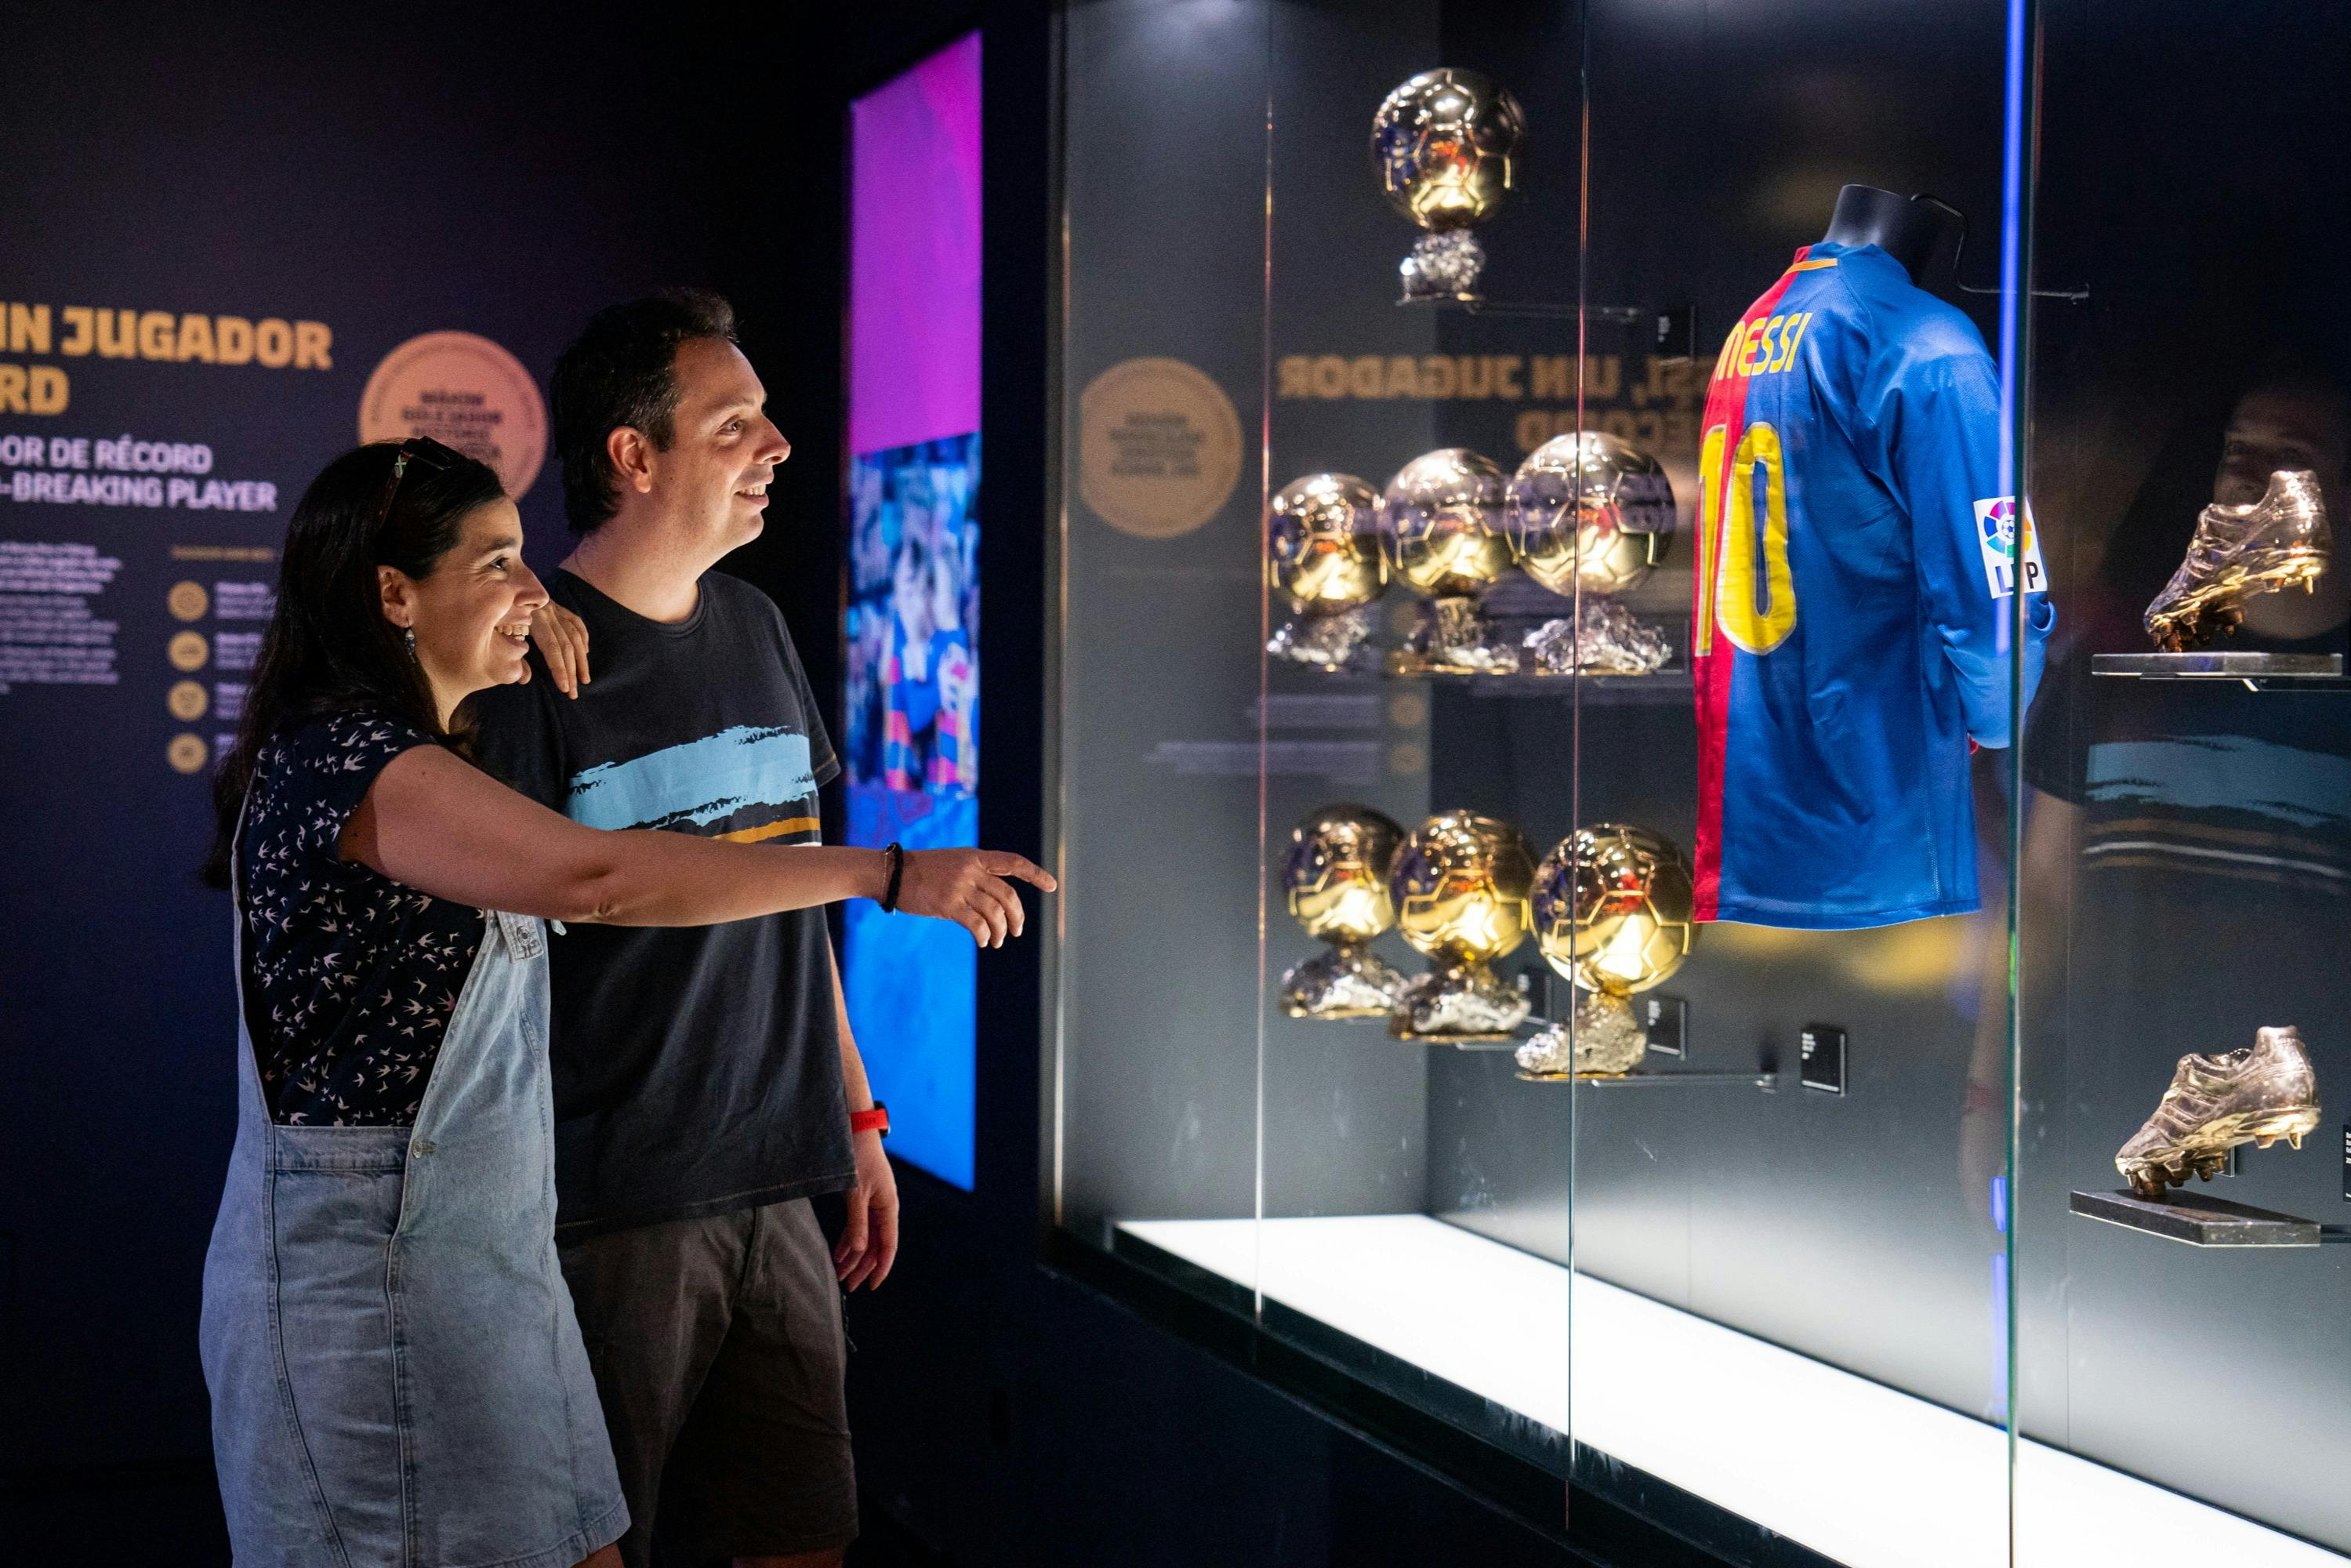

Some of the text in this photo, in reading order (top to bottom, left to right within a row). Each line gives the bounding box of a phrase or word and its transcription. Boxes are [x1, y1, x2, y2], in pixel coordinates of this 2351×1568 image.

[0, 302, 52, 354] N
[61, 306, 332, 370] JUGADOR
[1717, 312, 1813, 381] MESSI
[0, 364, 71, 416] RD
[49, 437, 89, 469] DE
[94, 434, 213, 474] RÉCORD
[167, 477, 278, 512] PLAYER
[1693, 421, 1798, 656] 10
[1994, 561, 2039, 593] LP
